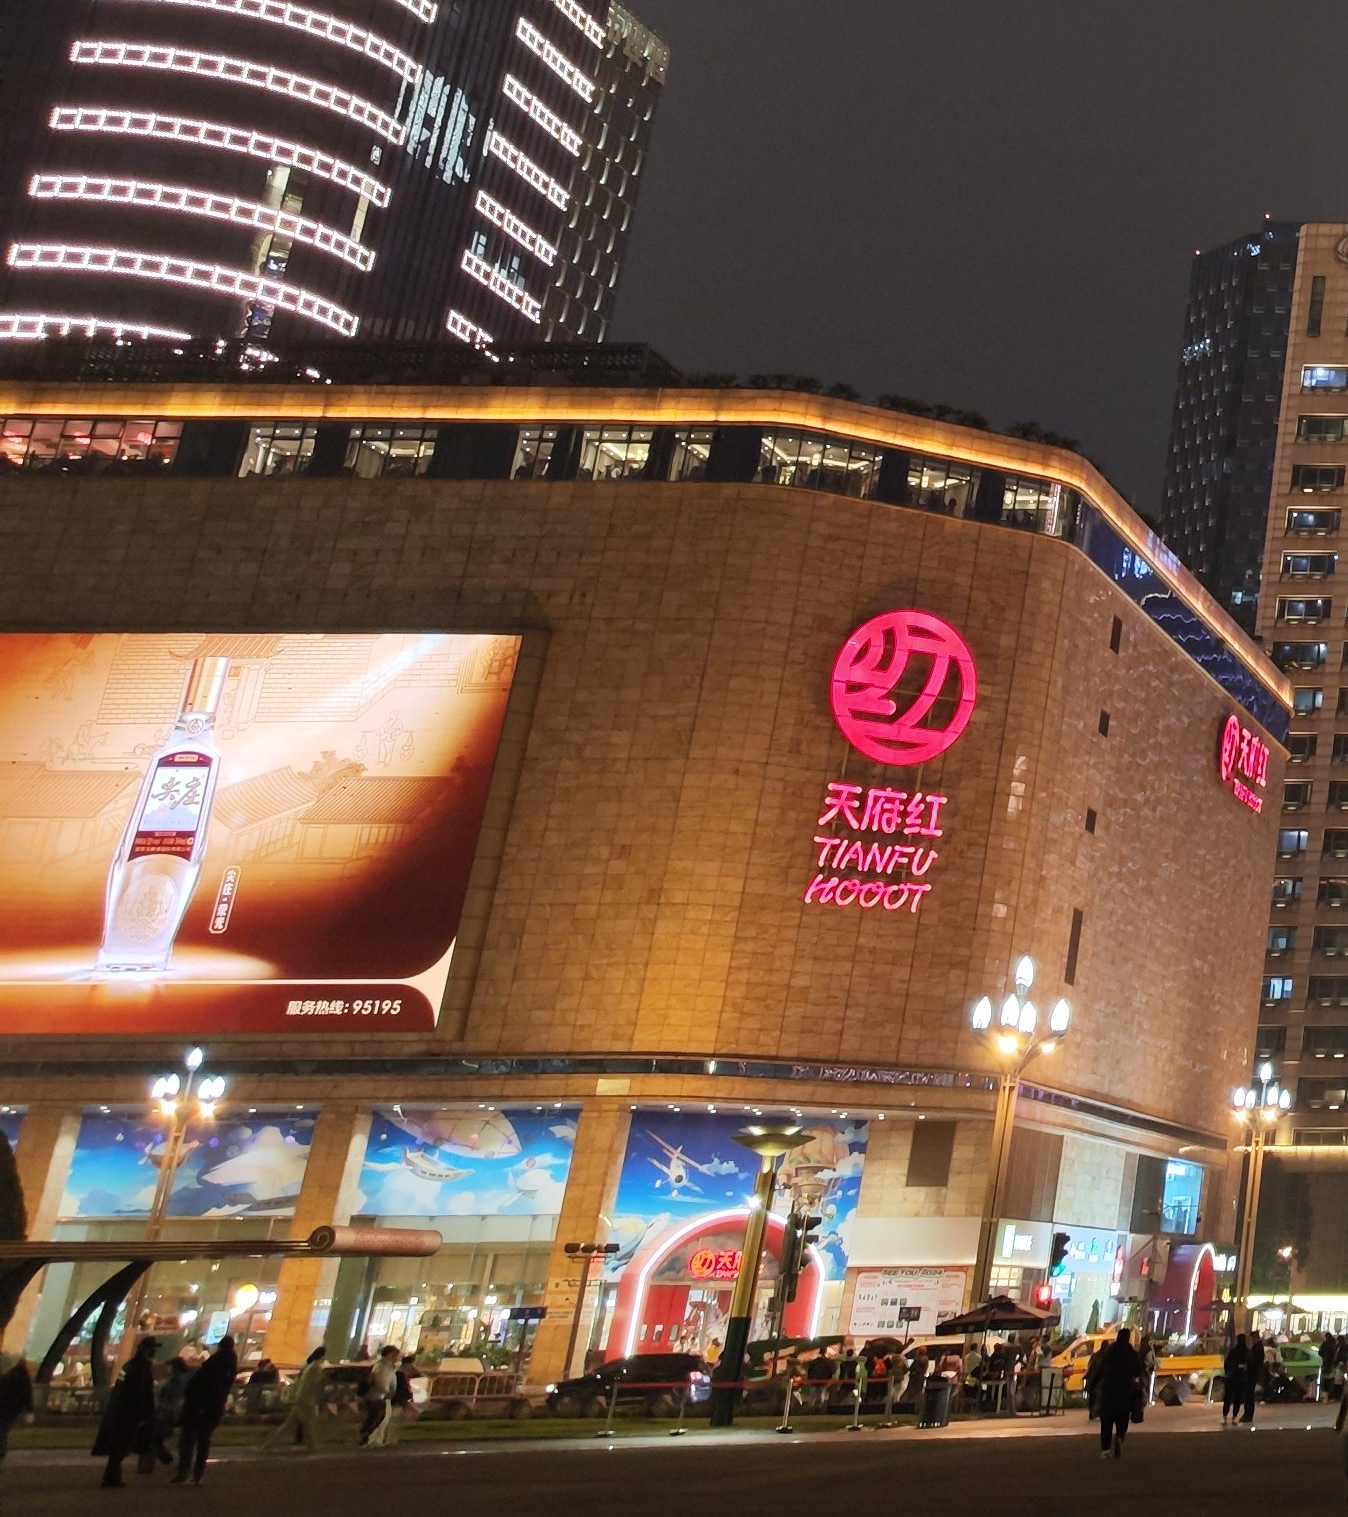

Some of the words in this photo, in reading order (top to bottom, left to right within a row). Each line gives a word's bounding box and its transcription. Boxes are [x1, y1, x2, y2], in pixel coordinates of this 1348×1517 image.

[817, 782, 948, 837] 天府红
[813, 835, 939, 876] TIANFU
